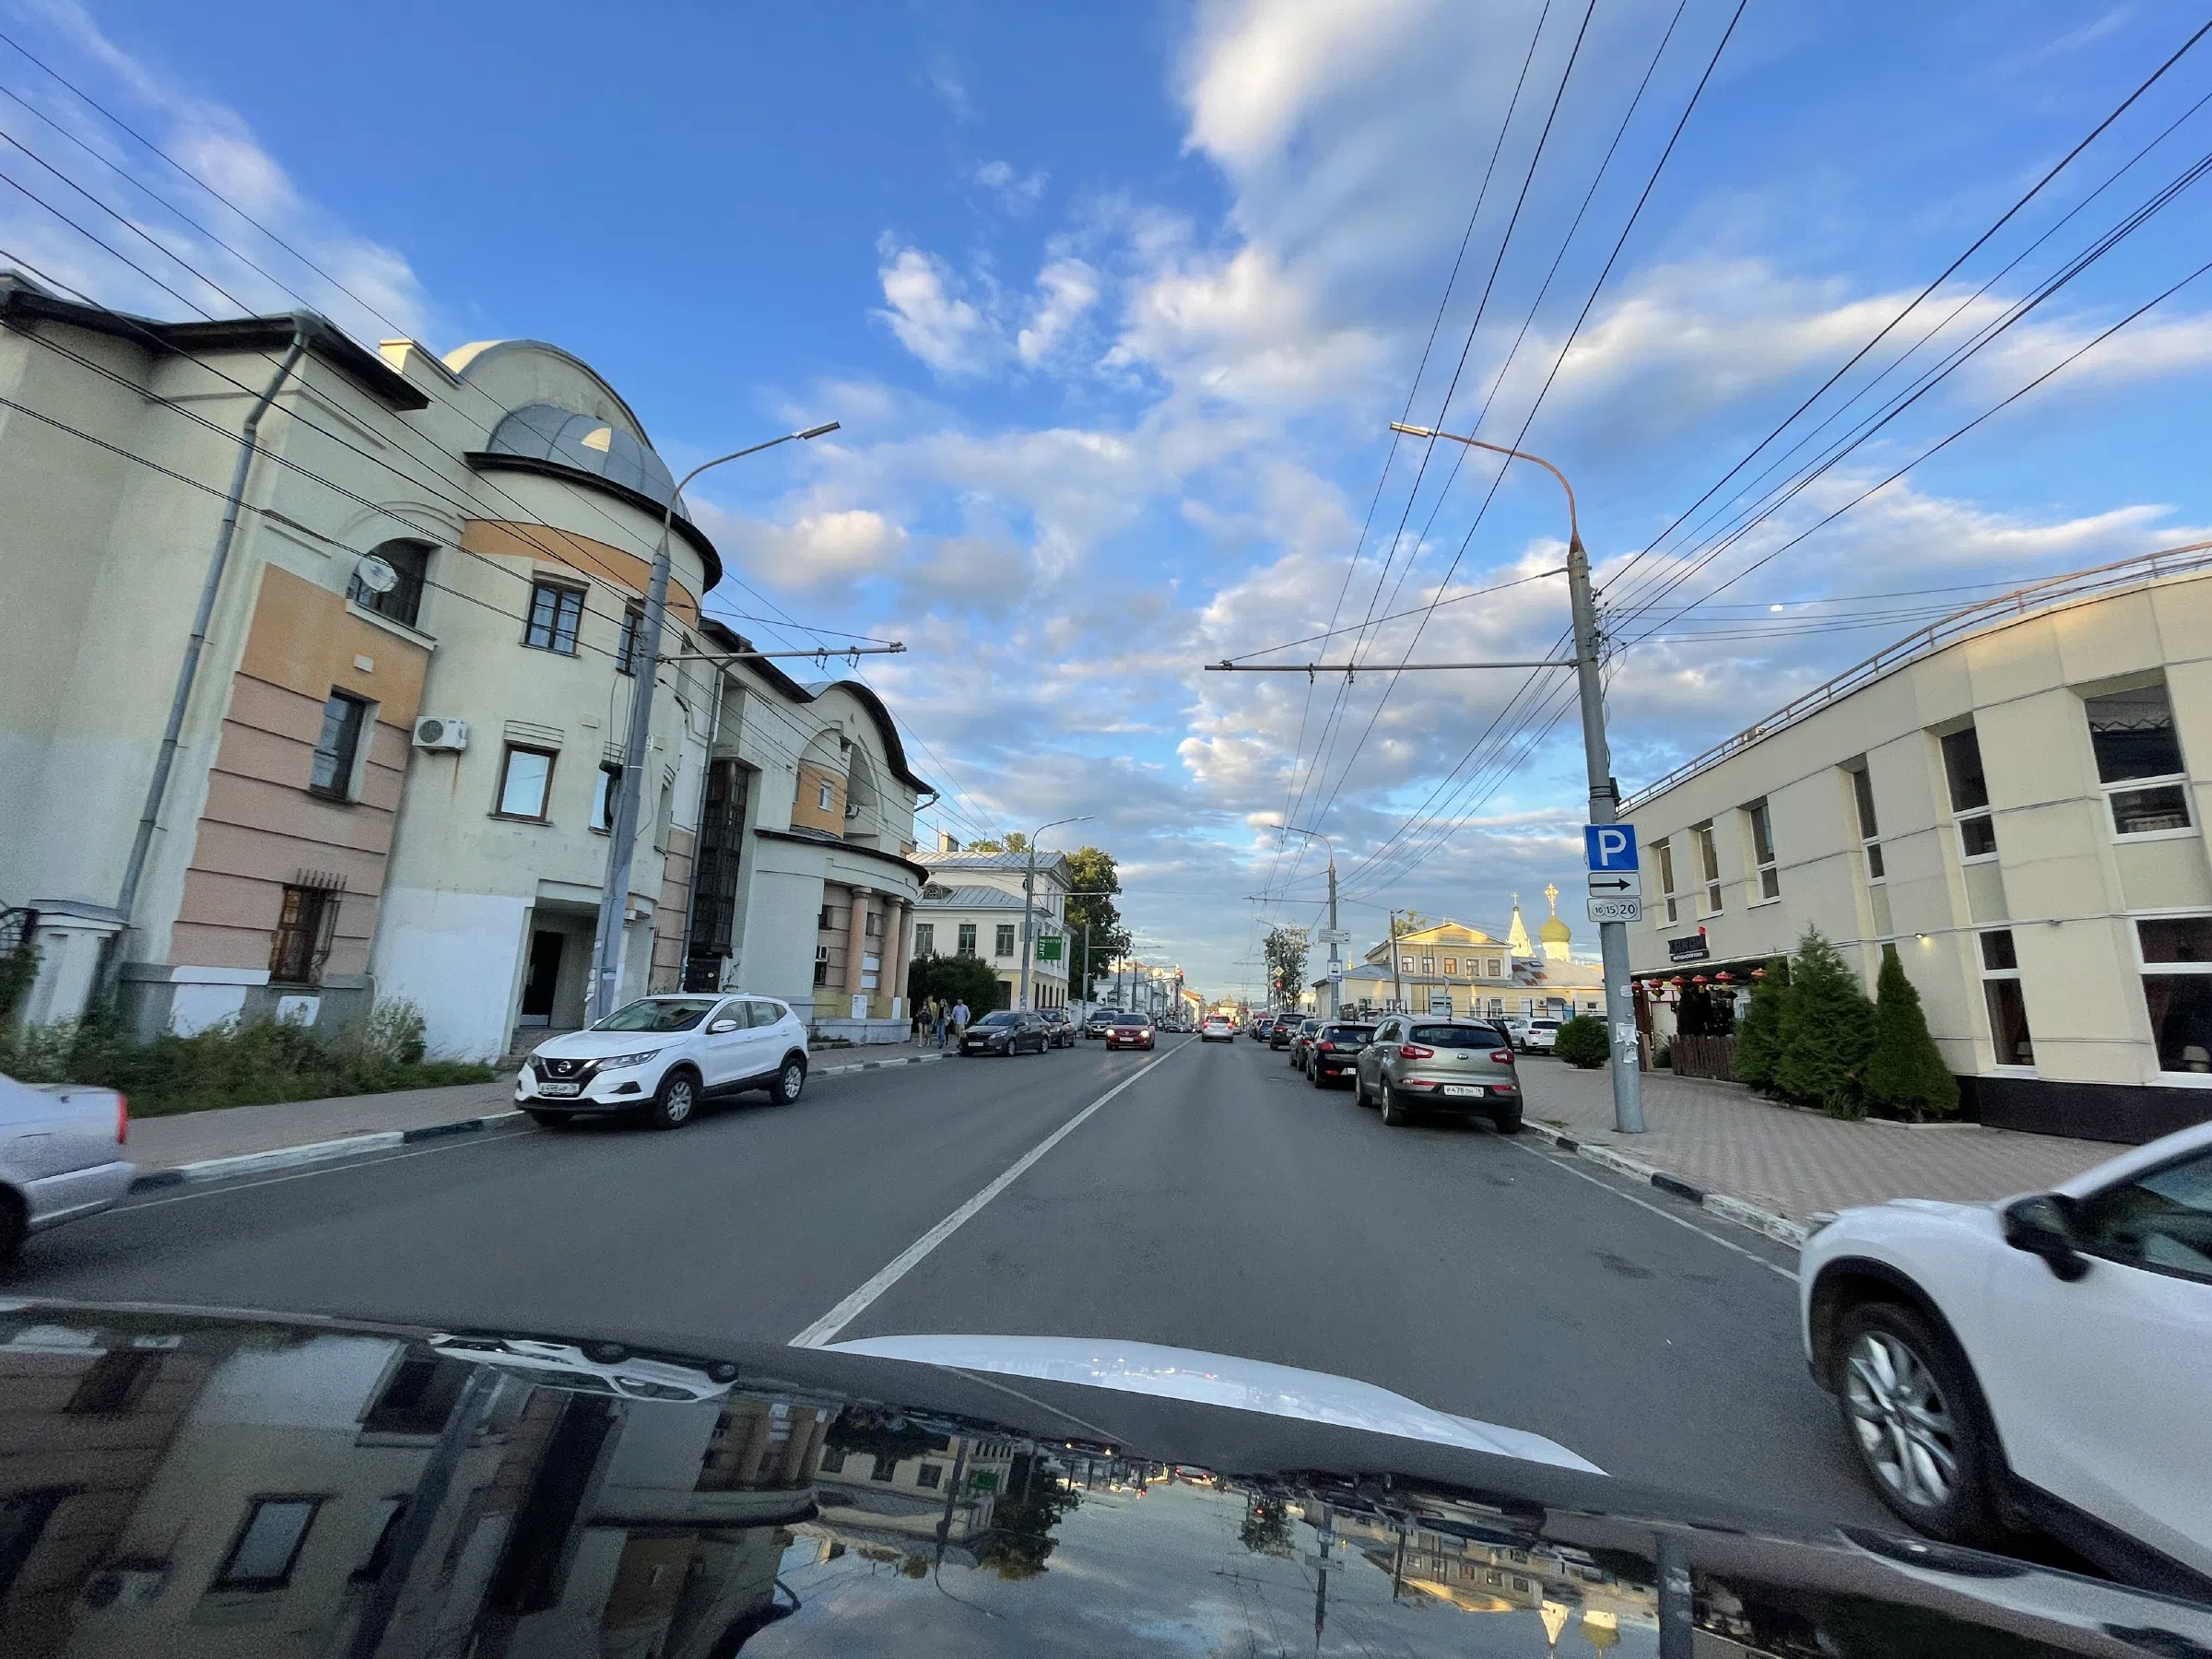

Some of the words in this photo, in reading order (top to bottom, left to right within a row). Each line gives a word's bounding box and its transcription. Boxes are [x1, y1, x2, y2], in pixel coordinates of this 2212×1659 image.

[1598, 830, 1627, 866] P
[1606, 905, 1616, 914] 15
[1619, 904, 1635, 914] 20
